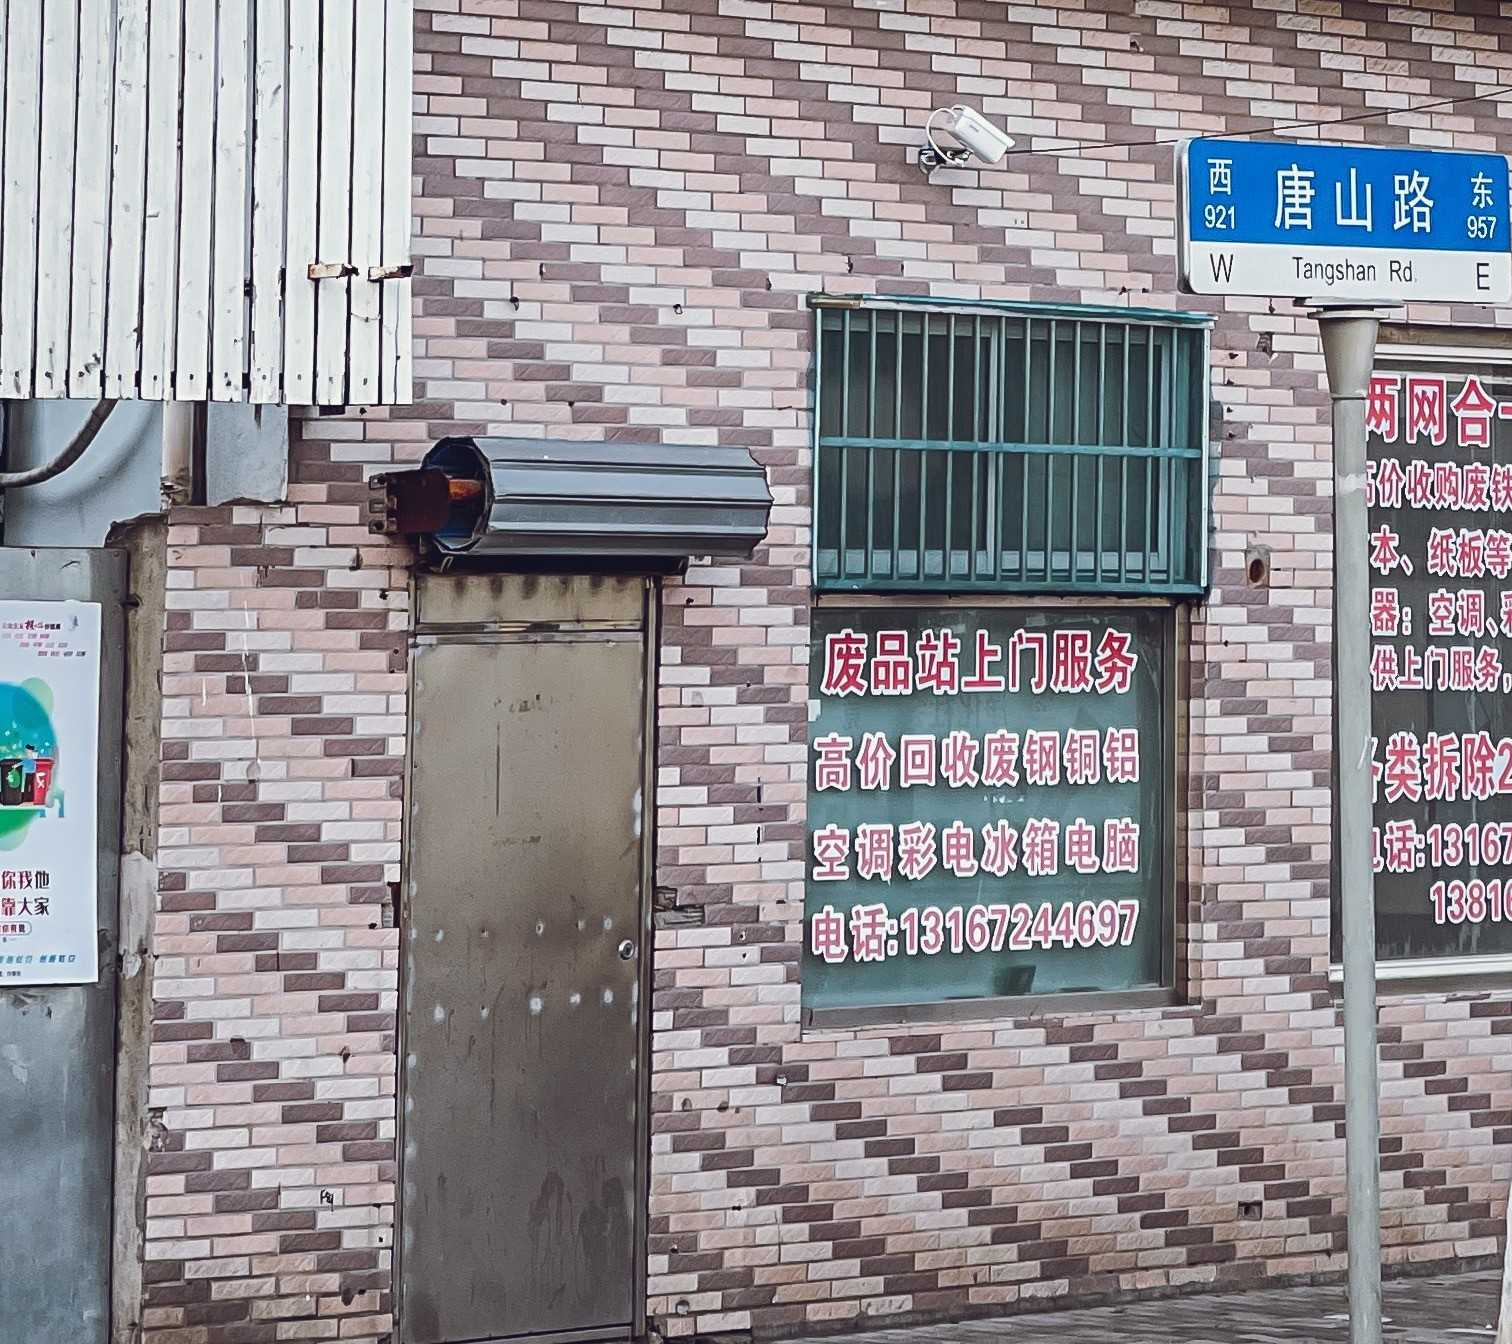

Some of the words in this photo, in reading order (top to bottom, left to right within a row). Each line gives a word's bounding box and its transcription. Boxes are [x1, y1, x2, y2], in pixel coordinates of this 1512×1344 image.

[1207, 158, 1233, 196] 西
[1470, 171, 1494, 209] 东
[1204, 204, 1236, 230] 921
[1274, 163, 1434, 233] 唐山路
[1467, 215, 1497, 239] 957
[1210, 253, 1234, 284] W
[1292, 256, 1376, 286] Tangshan
[1476, 262, 1490, 290] E
[820, 627, 1138, 696] 废品站上门服务
[813, 728, 1140, 791] 高价回收废钢铜铝
[812, 817, 1140, 881] 空调彩电冰箱电脑
[811, 900, 1140, 963] 电话:13167244697
